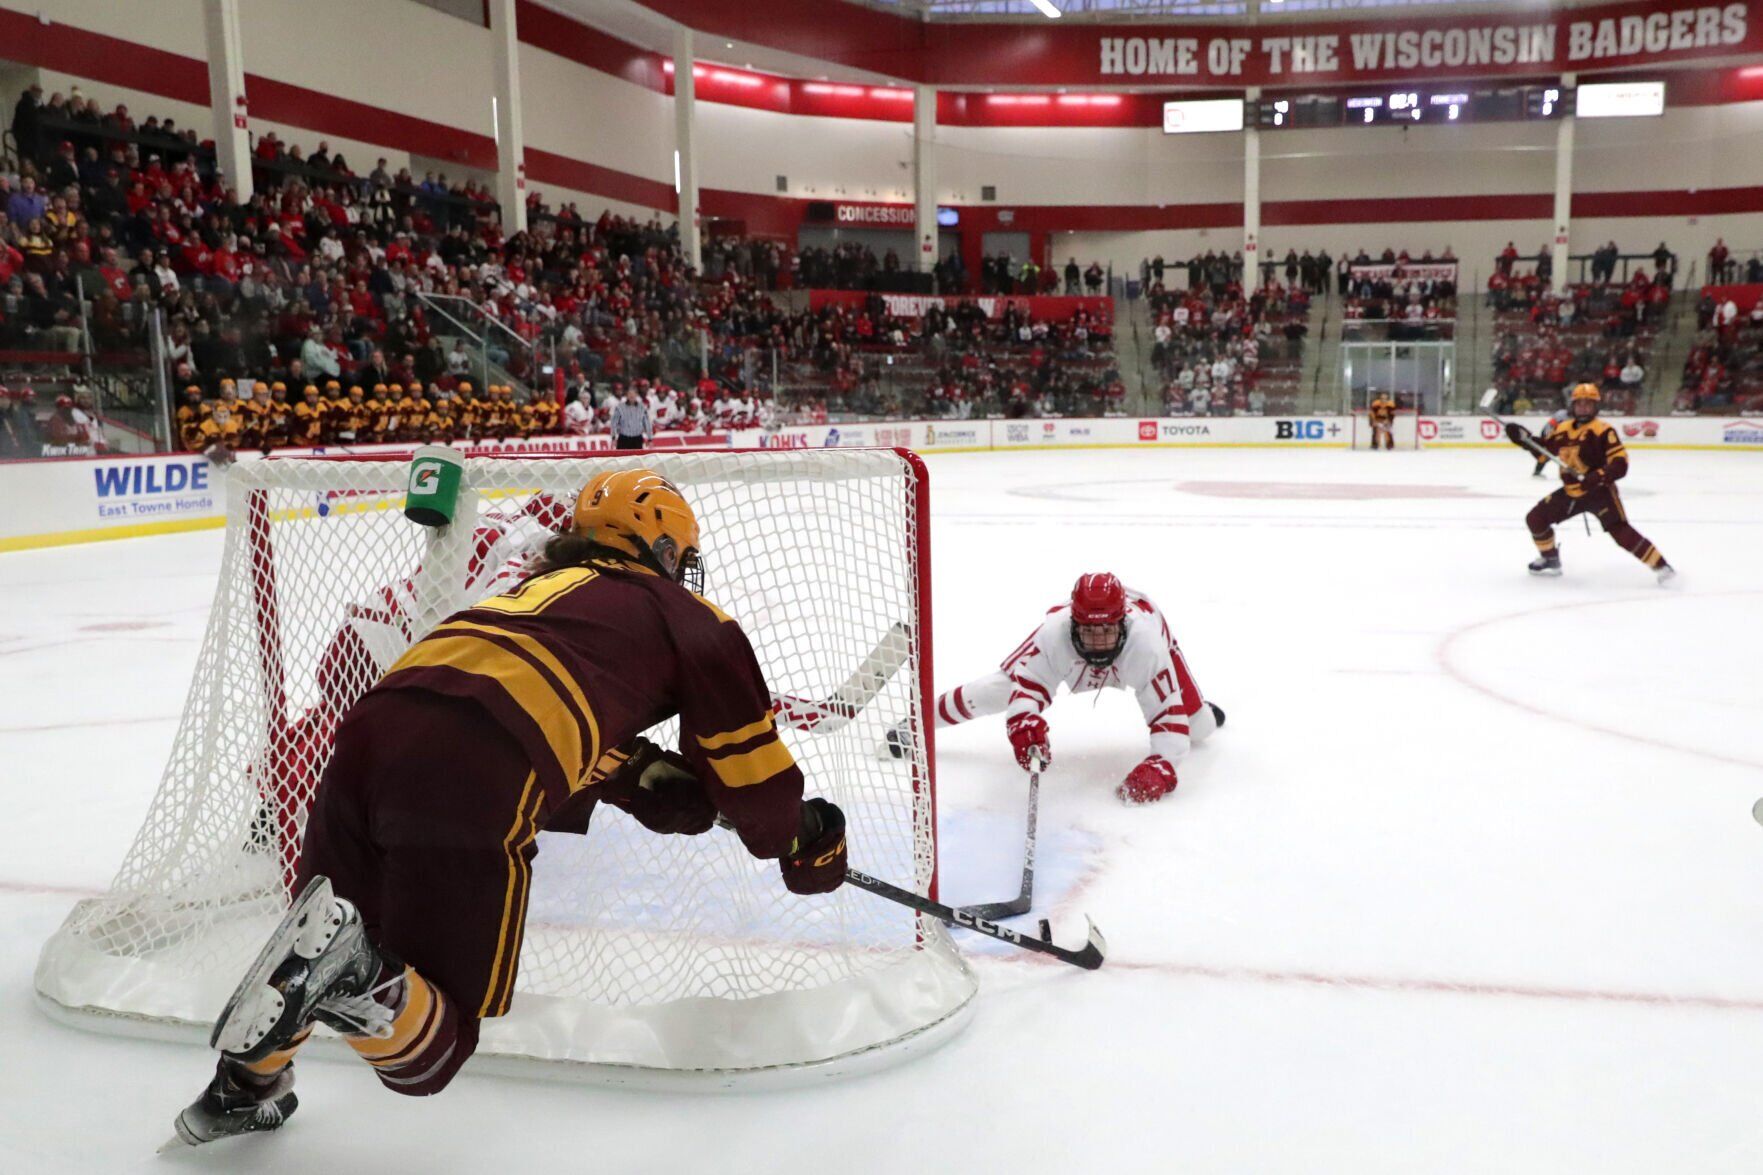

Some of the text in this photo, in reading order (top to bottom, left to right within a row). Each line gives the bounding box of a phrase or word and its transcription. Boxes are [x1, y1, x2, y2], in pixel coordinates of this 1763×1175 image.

[1100, 4, 1748, 75] HOME OF THE WISCONSIN BADGERS
[1162, 426, 1210, 435] TOYOTA
[94, 462, 209, 497] WILDE
[410, 461, 441, 495] G
[99, 497, 213, 518] East Towne Honda
[1151, 668, 1176, 703] 17
[953, 908, 1021, 944] CCM
